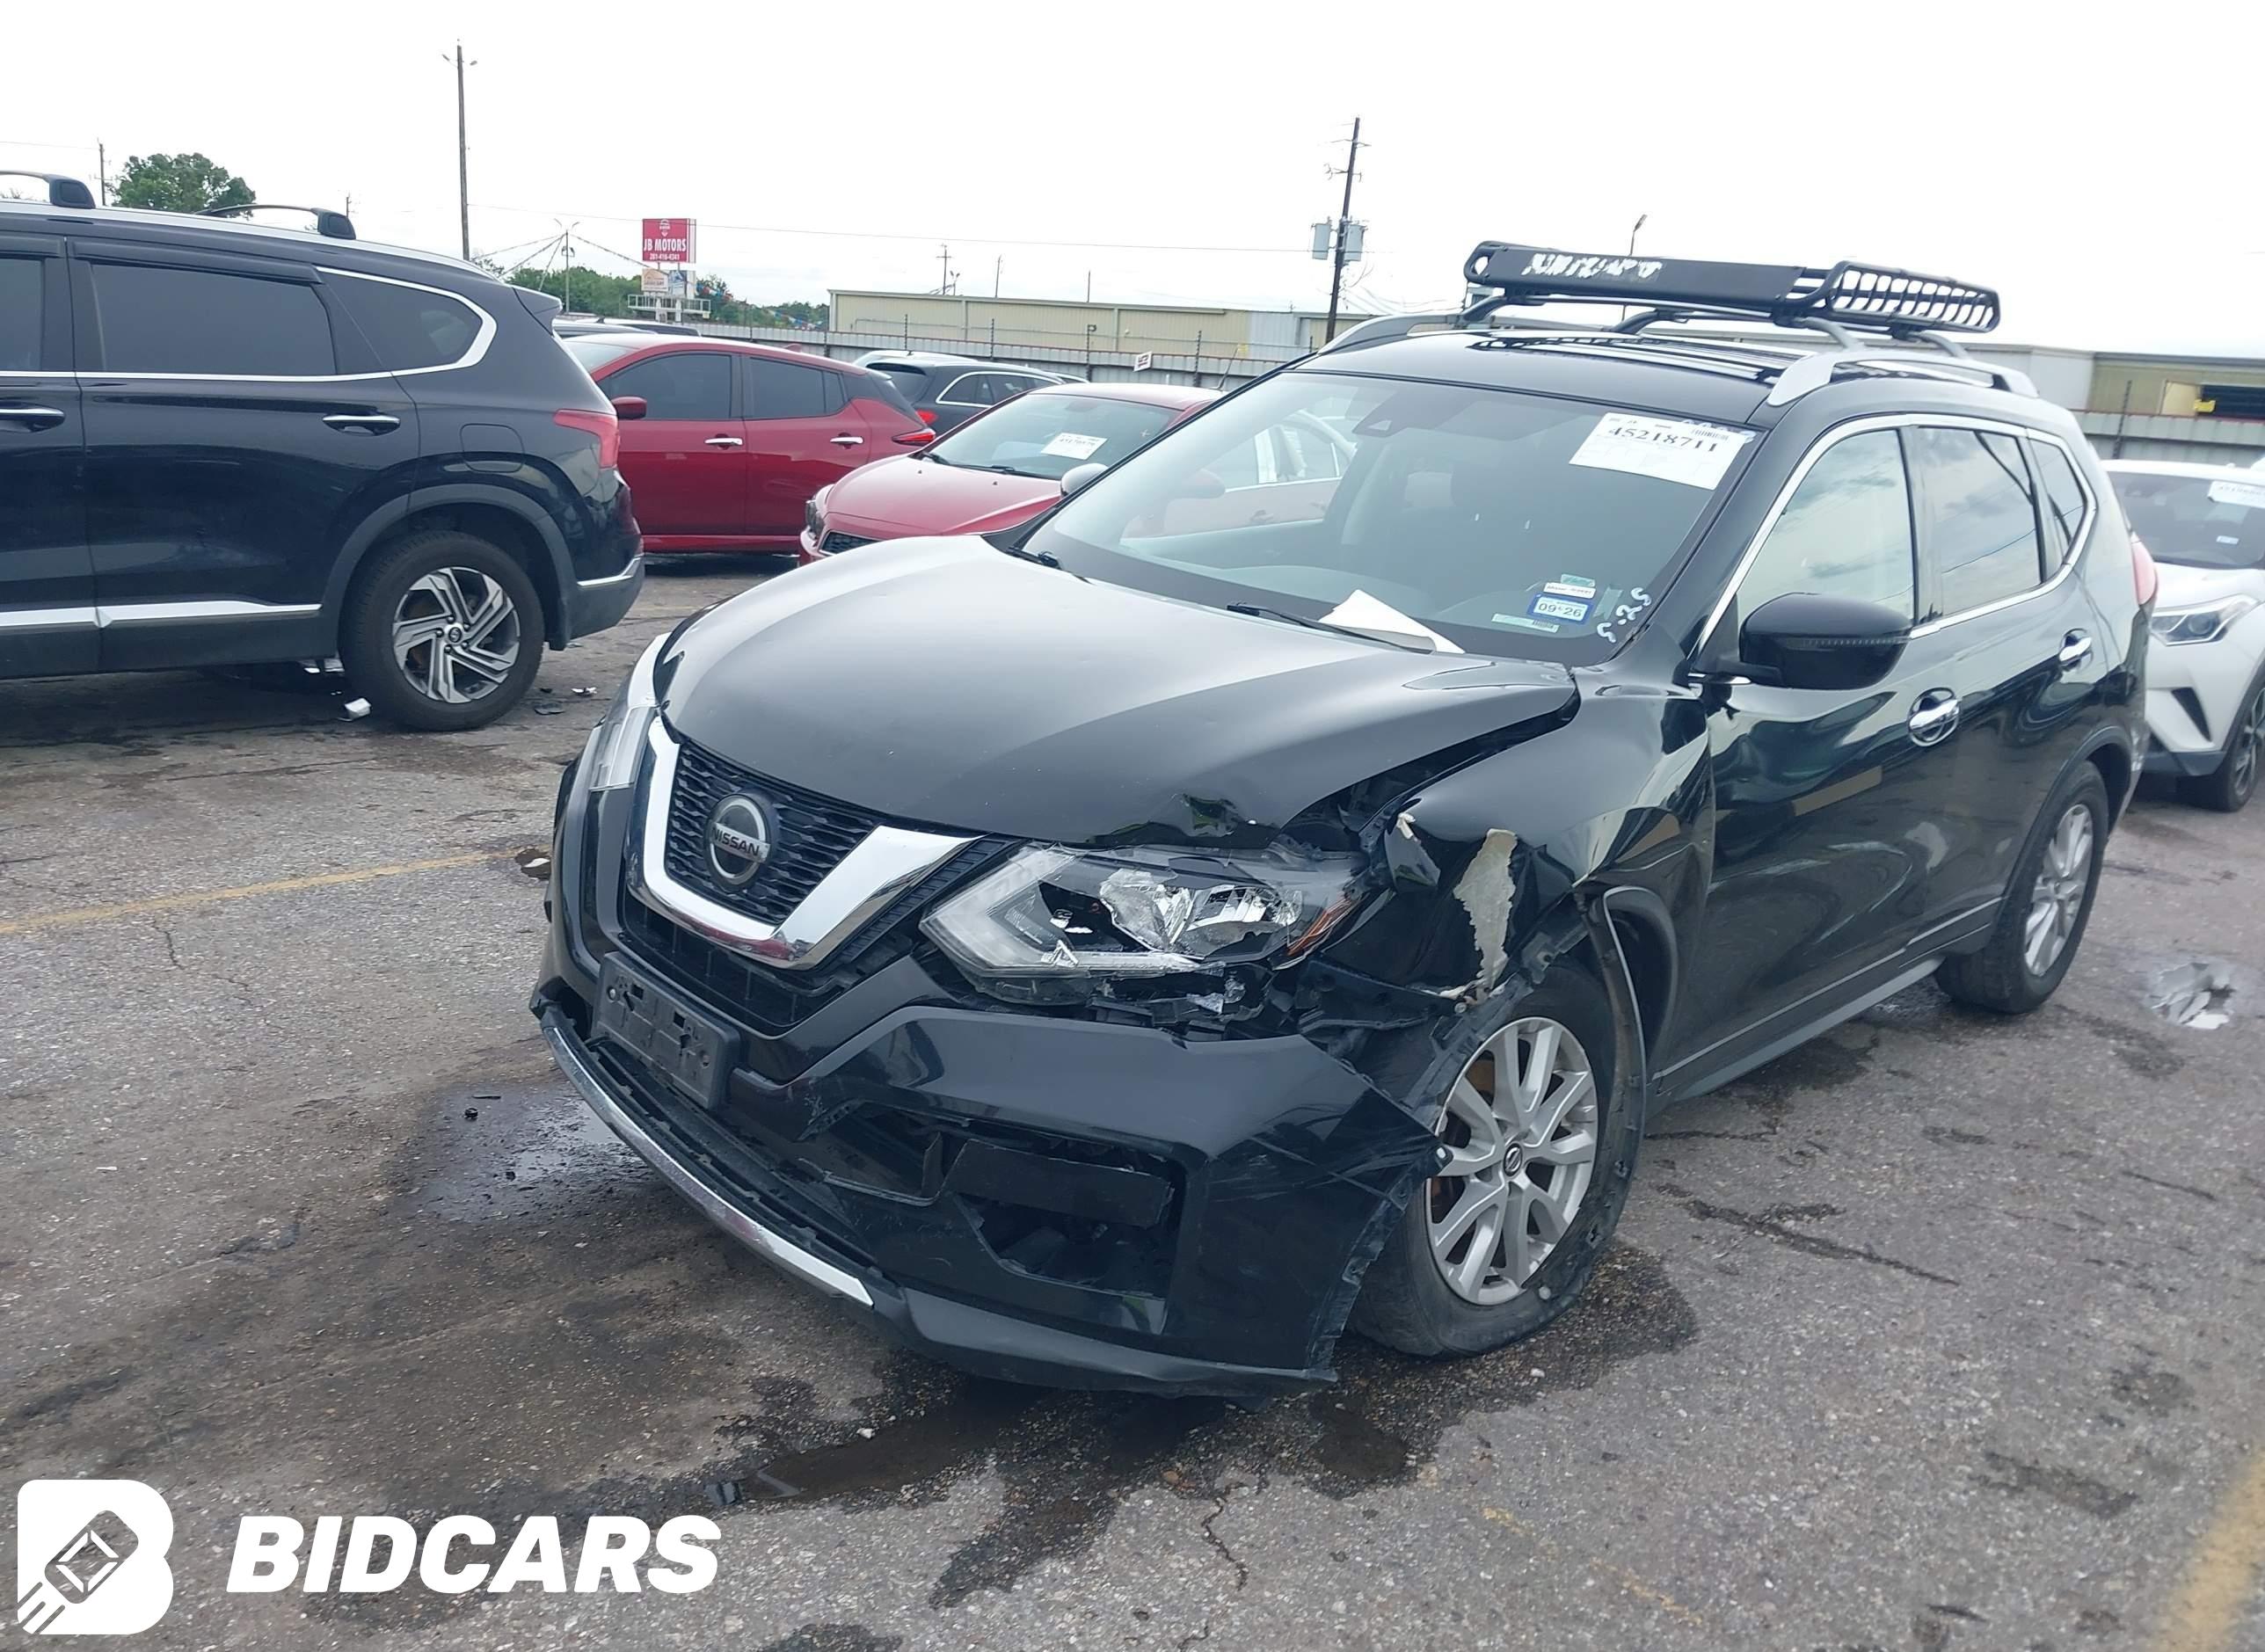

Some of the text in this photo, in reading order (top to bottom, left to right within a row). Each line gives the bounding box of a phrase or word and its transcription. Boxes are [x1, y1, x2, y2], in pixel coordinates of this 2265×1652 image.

[644, 238, 686, 252] JB MOTORS
[1608, 426, 1717, 453] 45218711
[1539, 602, 1556, 613] 09
[1562, 607, 1582, 617] 26
[712, 827, 760, 856] NISSAN
